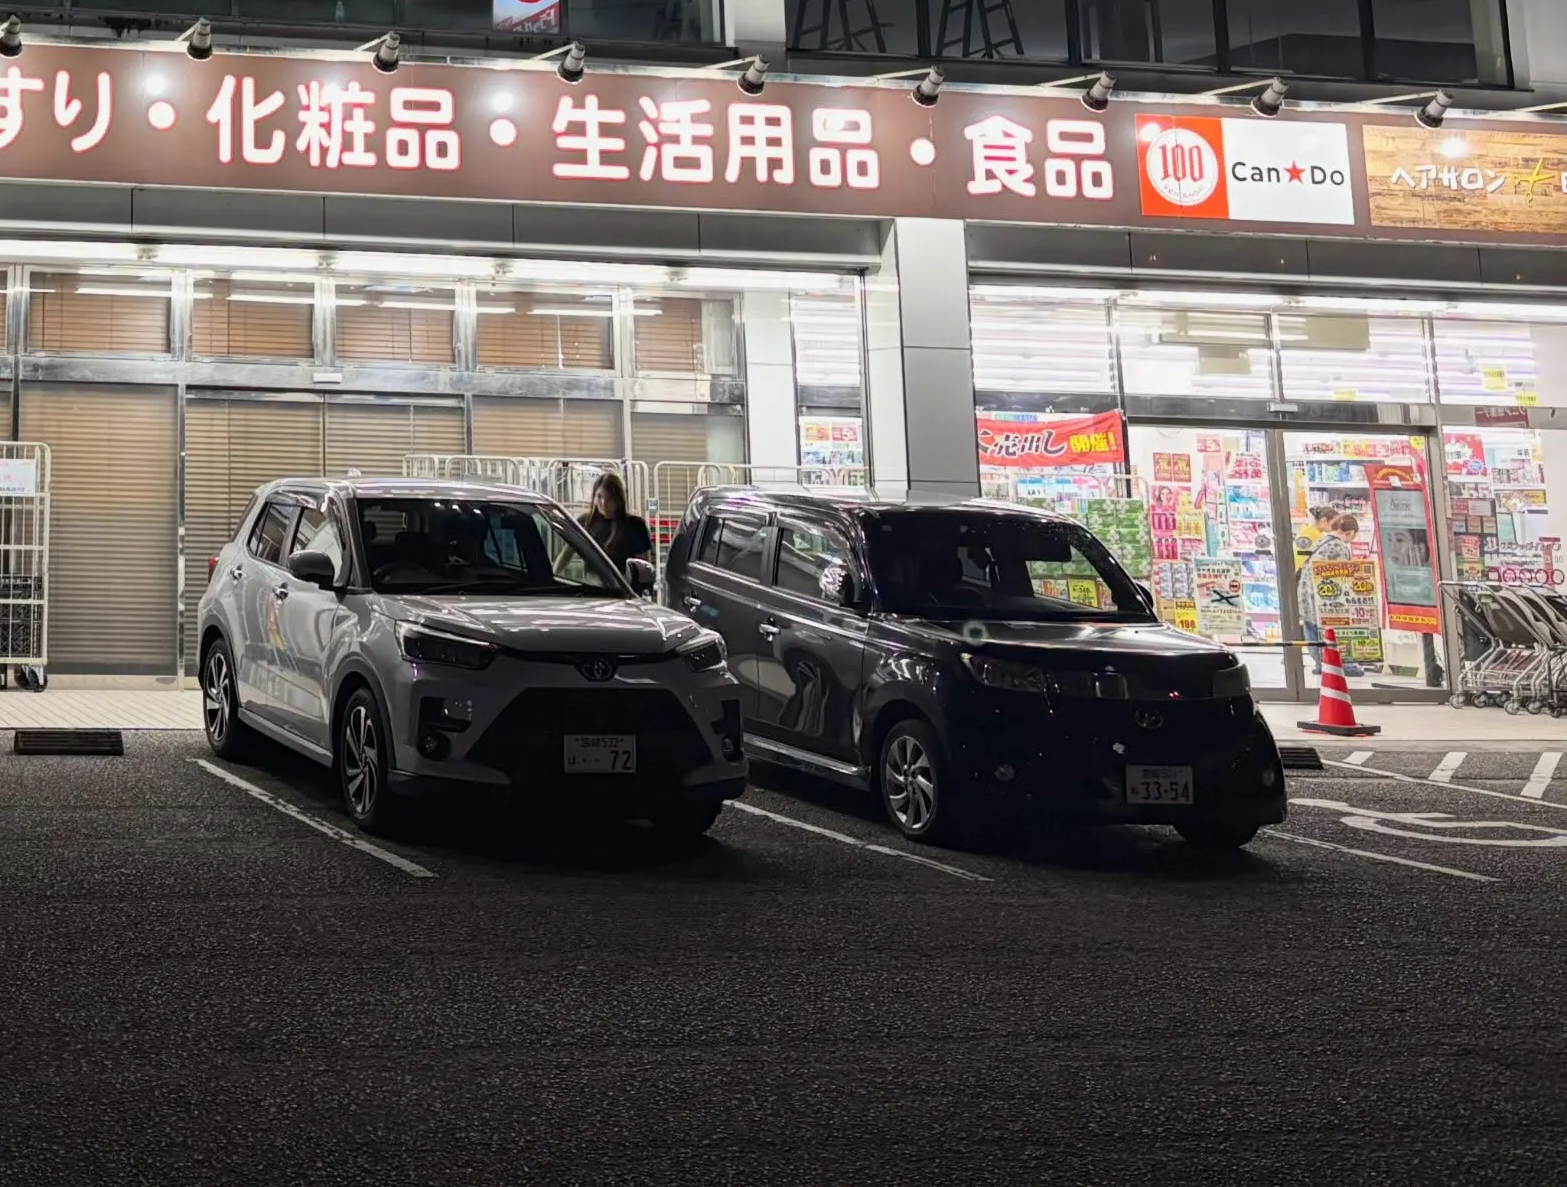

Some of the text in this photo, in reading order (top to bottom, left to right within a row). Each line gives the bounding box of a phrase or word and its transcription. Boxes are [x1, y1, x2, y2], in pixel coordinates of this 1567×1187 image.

[1159, 144, 1203, 182] 100
[1391, 164, 1506, 194] ヘアサロン
